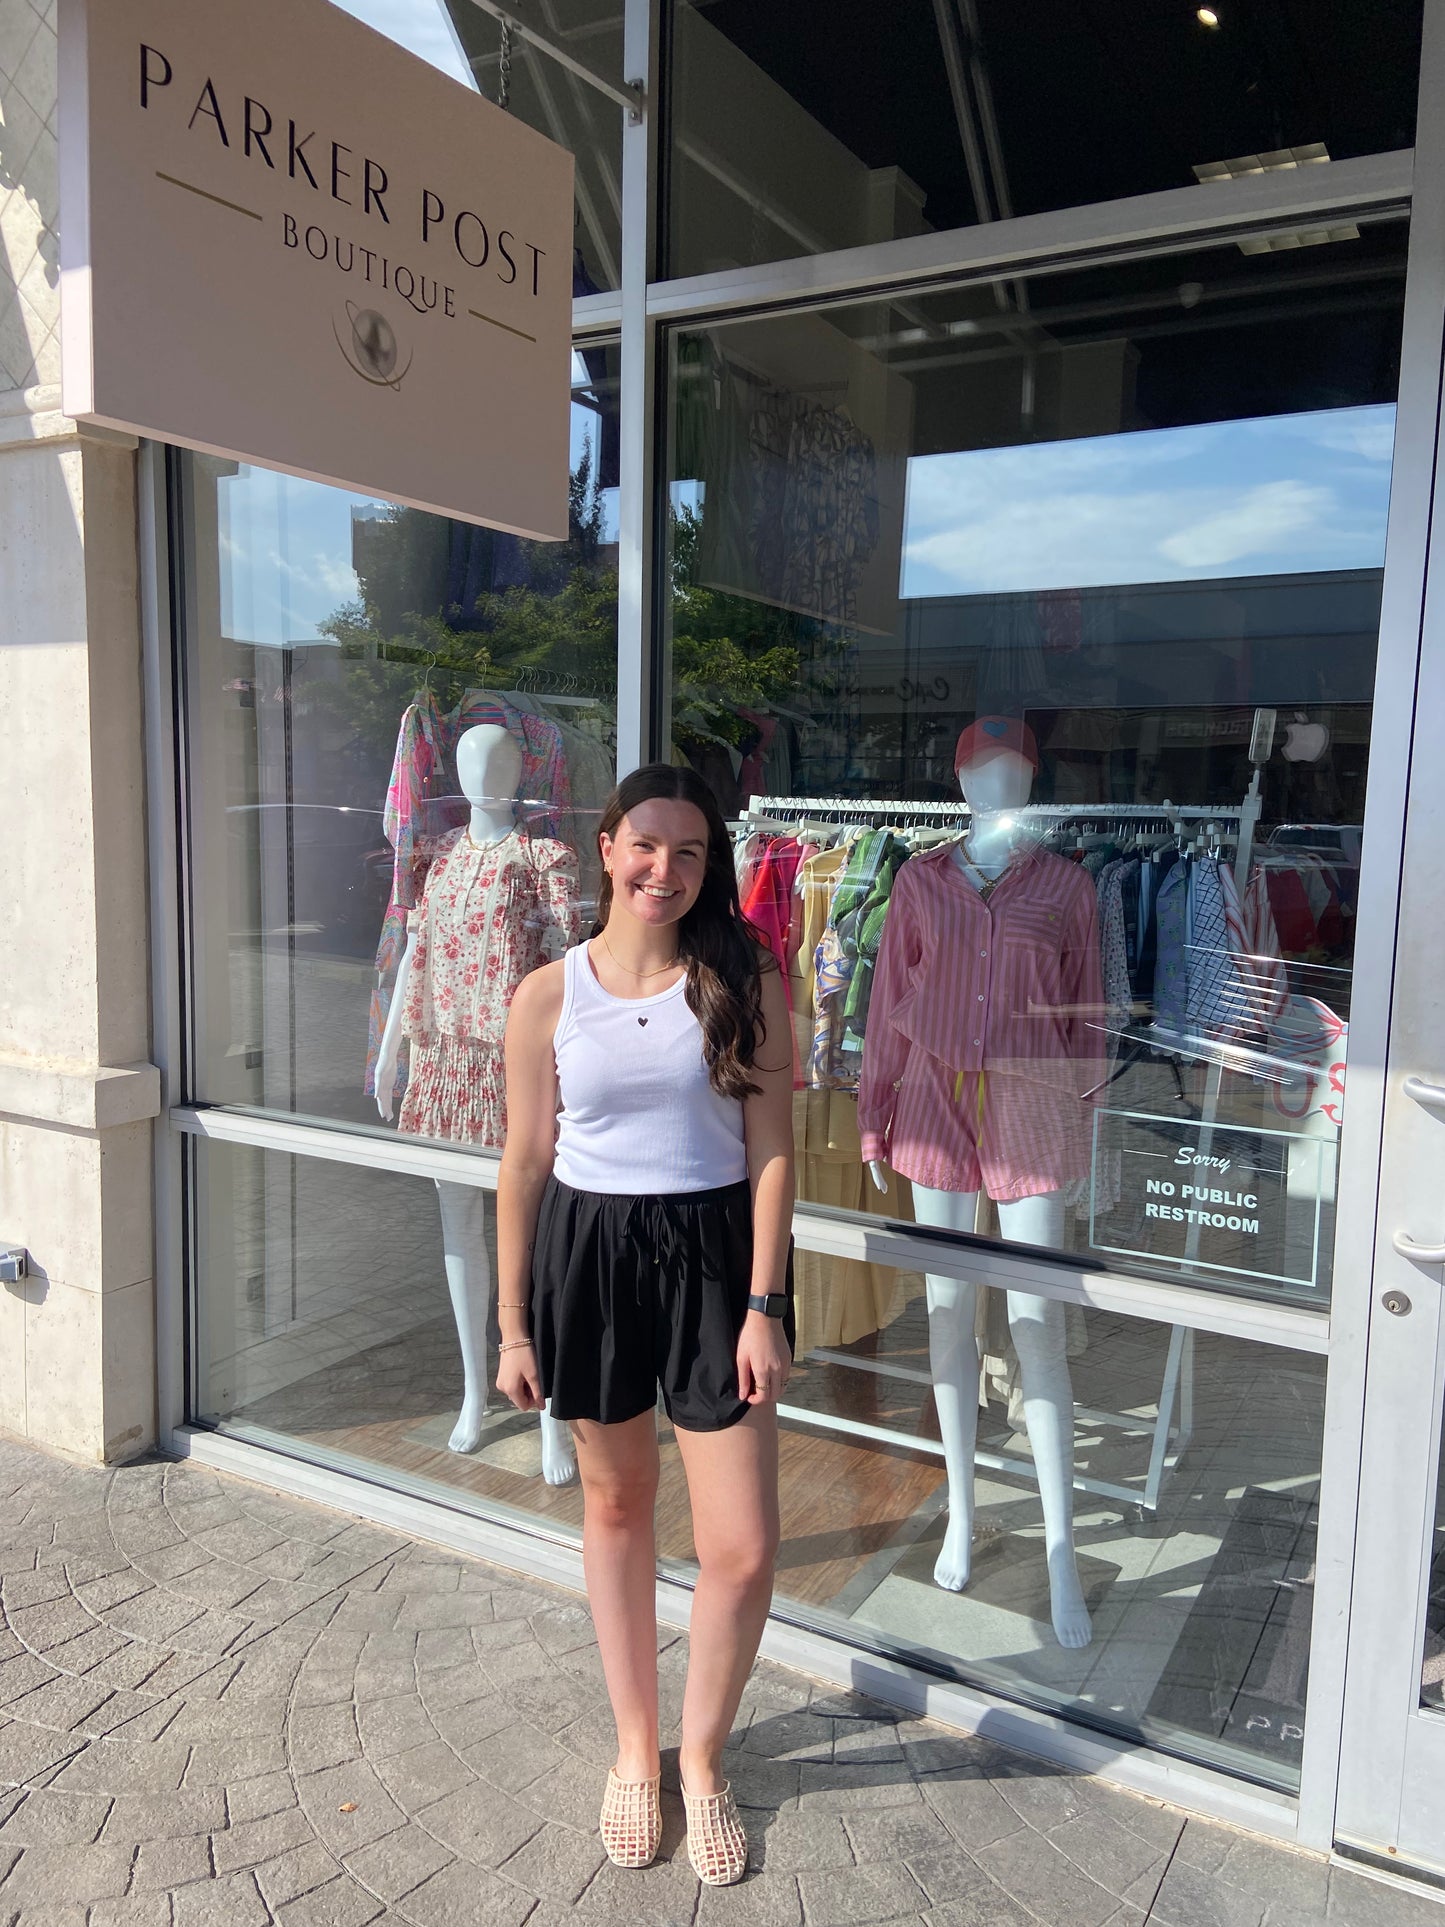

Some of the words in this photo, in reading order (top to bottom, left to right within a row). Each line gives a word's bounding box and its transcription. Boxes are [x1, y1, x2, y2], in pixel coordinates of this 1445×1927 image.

[139, 43, 390, 224] PARKER
[421, 189, 546, 296] POST
[282, 213, 456, 318] BOUTIQUE
[1174, 1147, 1231, 1174] Sorry
[1146, 1179, 1176, 1197] NO
[1181, 1184, 1258, 1209] PUBLIC
[1145, 1203, 1260, 1234] RESTROOM
